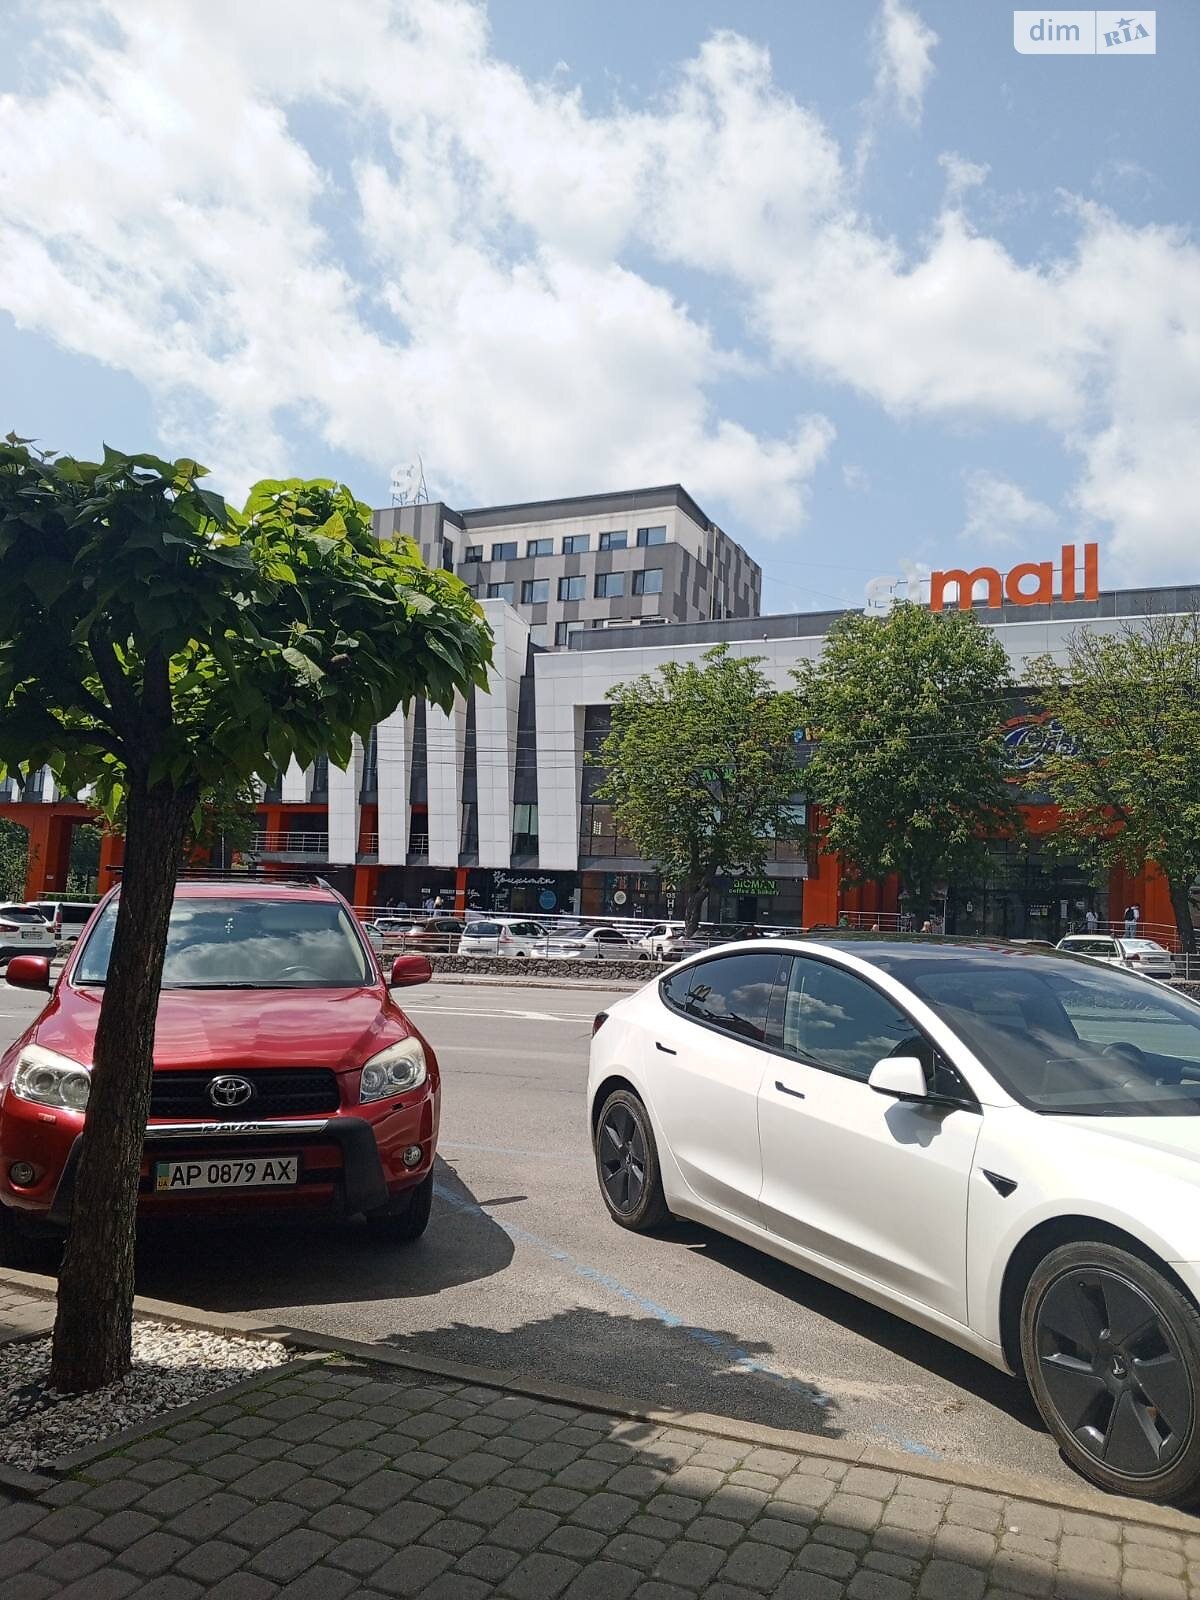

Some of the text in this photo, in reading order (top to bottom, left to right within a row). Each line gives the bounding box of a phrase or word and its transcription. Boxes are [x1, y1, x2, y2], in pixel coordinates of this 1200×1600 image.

[929, 542, 1099, 612] mall
[170, 1160, 291, 1187] AP 0879 AX
